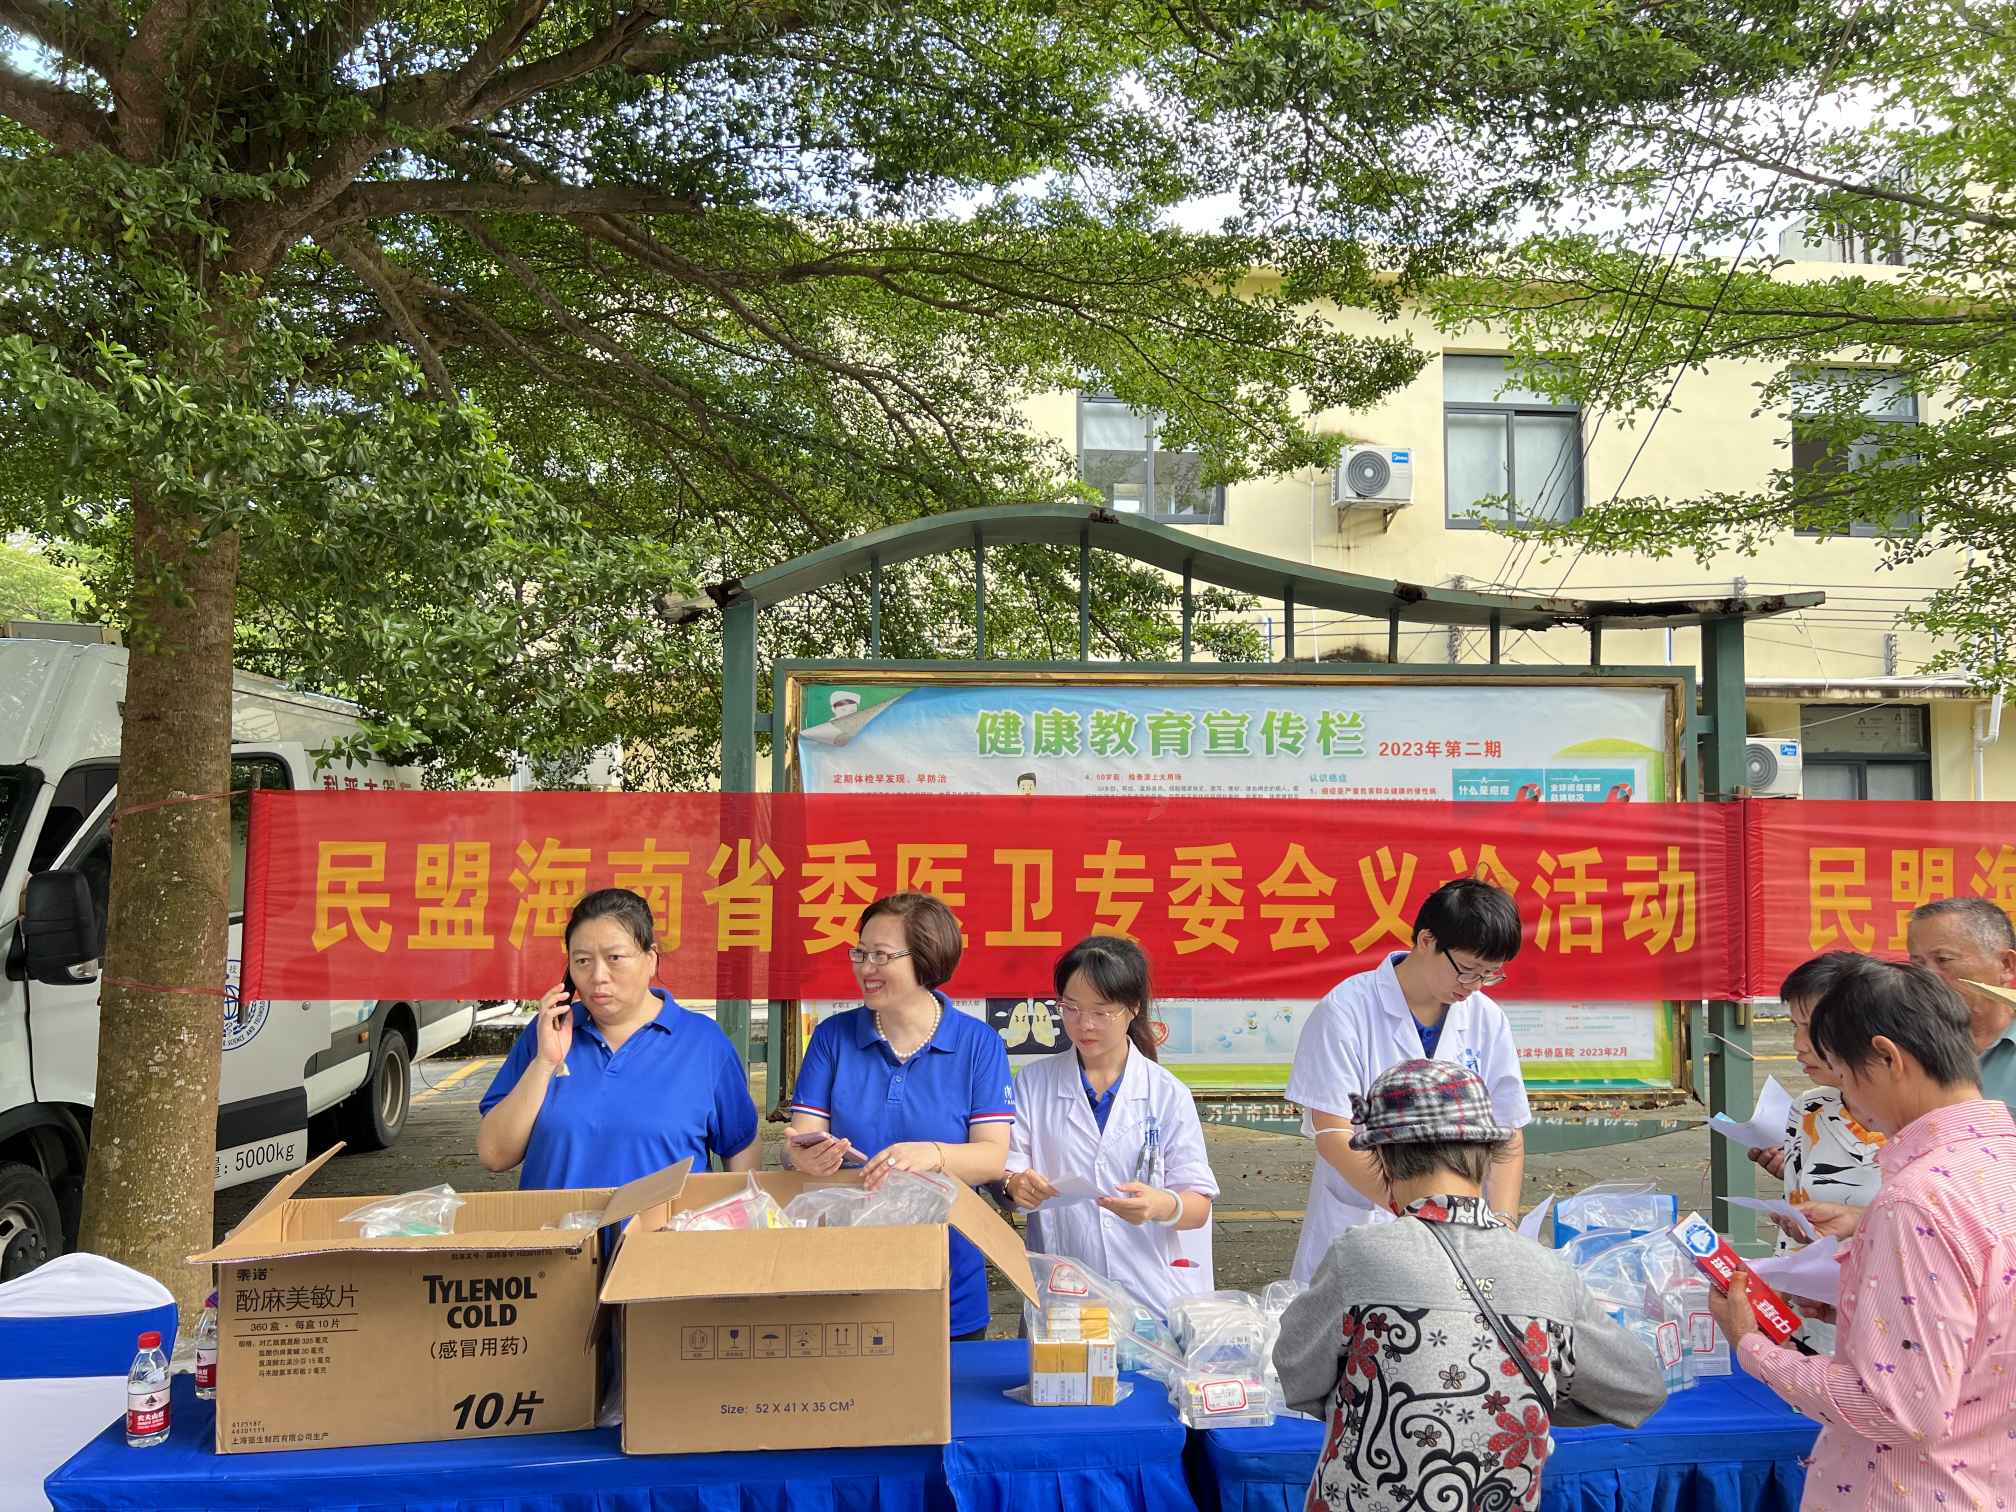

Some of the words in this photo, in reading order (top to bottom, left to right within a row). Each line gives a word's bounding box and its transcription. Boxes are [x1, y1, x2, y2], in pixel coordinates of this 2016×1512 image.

[975, 709, 1367, 757] 健康教育宣传栏
[1579, 1047, 1627, 1057] 2023年2月
[235, 1283, 359, 1313] 酚麻美敏片
[423, 1275, 537, 1304] TYLENOL
[447, 1303, 518, 1329] COLD
[453, 1391, 544, 1430] 10片
[720, 1404, 748, 1414] Size:
[755, 1403, 769, 1414] 52
[772, 1403, 780, 1413] X
[784, 1402, 796, 1413] 41
[801, 1402, 809, 1412] X
[813, 1401, 826, 1412] 35
